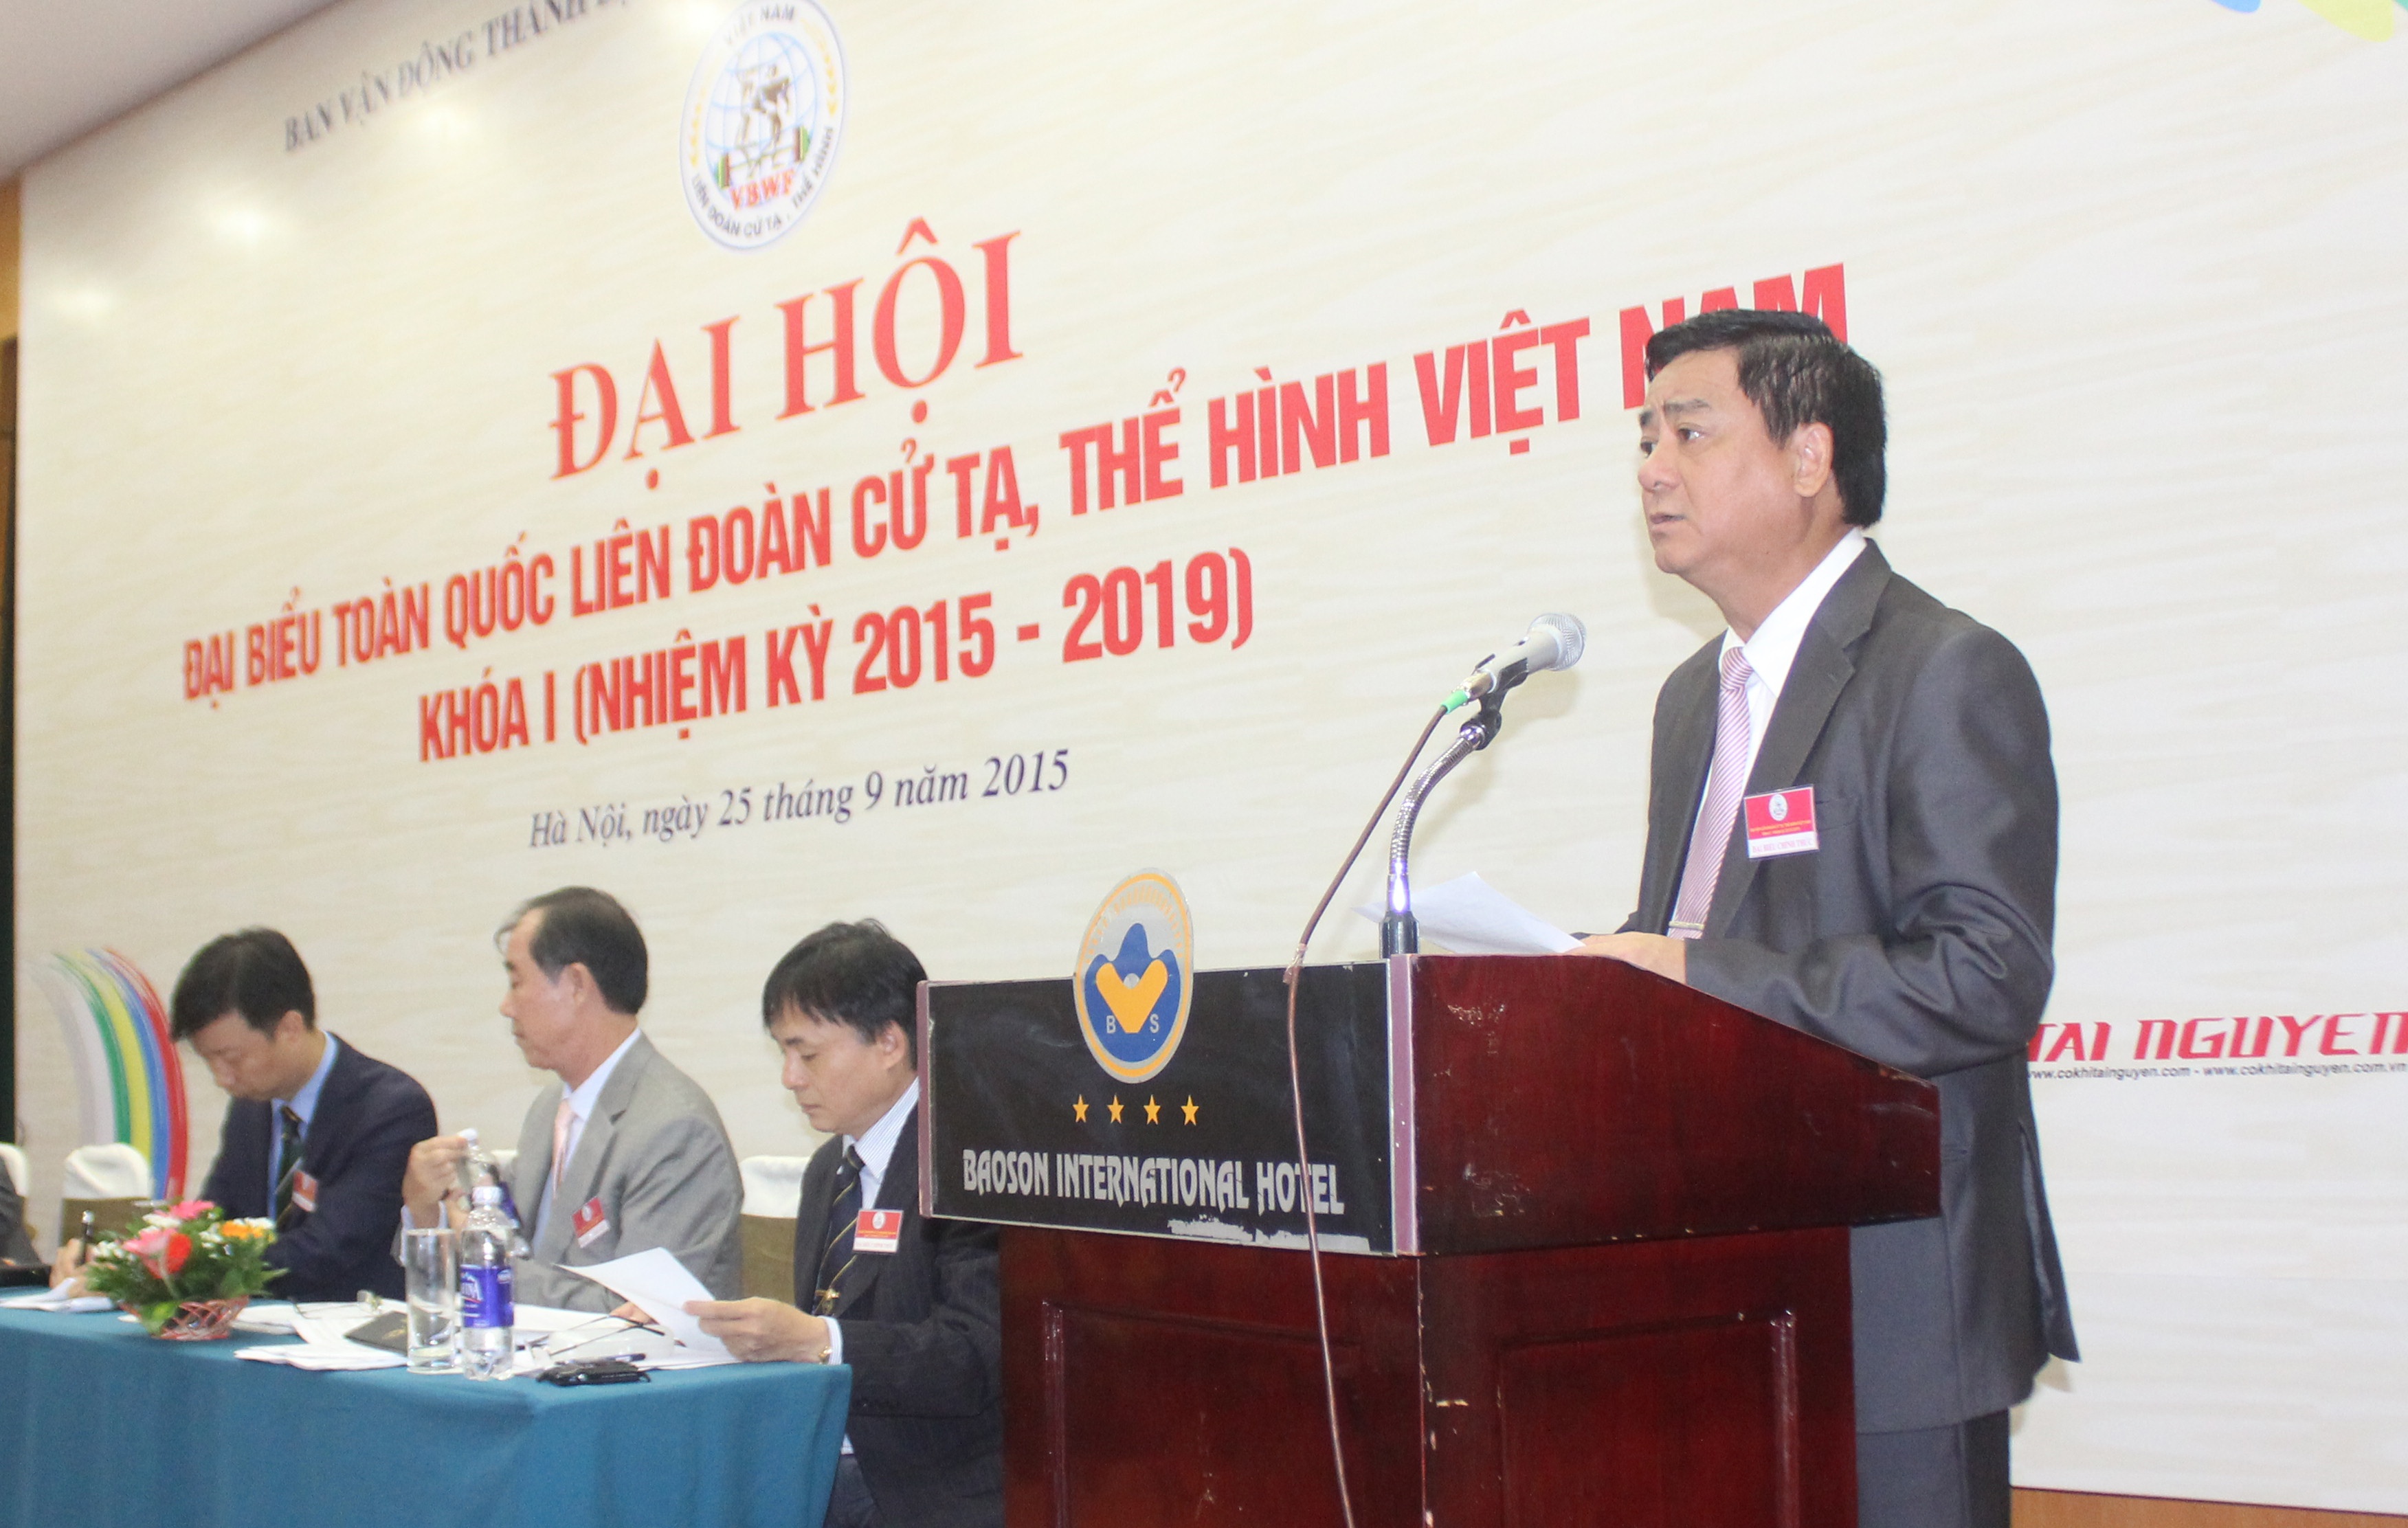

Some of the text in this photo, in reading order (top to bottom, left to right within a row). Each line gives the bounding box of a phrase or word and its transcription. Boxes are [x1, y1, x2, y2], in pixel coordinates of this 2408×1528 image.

[759, 3, 796, 21] NAM
[283, 101, 332, 153] BAN
[730, 168, 796, 210] VBWF
[549, 216, 1024, 491] ĐẠI HỘI
[183, 629, 235, 710] ĐẠI
[245, 585, 322, 687] BIỂU
[332, 576, 430, 668] TOÀN
[444, 530, 556, 650] QUỐC
[570, 518, 671, 618] LIÊN
[686, 482, 832, 593] ĐOÀN
[851, 438, 936, 559] CỬ
[946, 445, 1040, 552] TẠ,
[1059, 368, 1187, 517] THỂ
[1207, 362, 1391, 489] HÌNH
[1414, 308, 1591, 456] VIỆT
[419, 666, 531, 762] KHÓA
[544, 671, 557, 743] I
[573, 628, 748, 746] (NHIỆM
[766, 604, 834, 708] KỲ
[853, 592, 995, 695] 2015
[1062, 547, 1254, 664] 2019)
[529, 748, 1069, 848] Hà Nội, ngày 25 tháng 9 năm 2015
[1106, 1013, 1160, 1034] B S
[2028, 1022, 2112, 1062] TAI
[963, 1149, 1049, 1197] BAOSON
[1056, 1153, 1249, 1215] INTERNATIONAL
